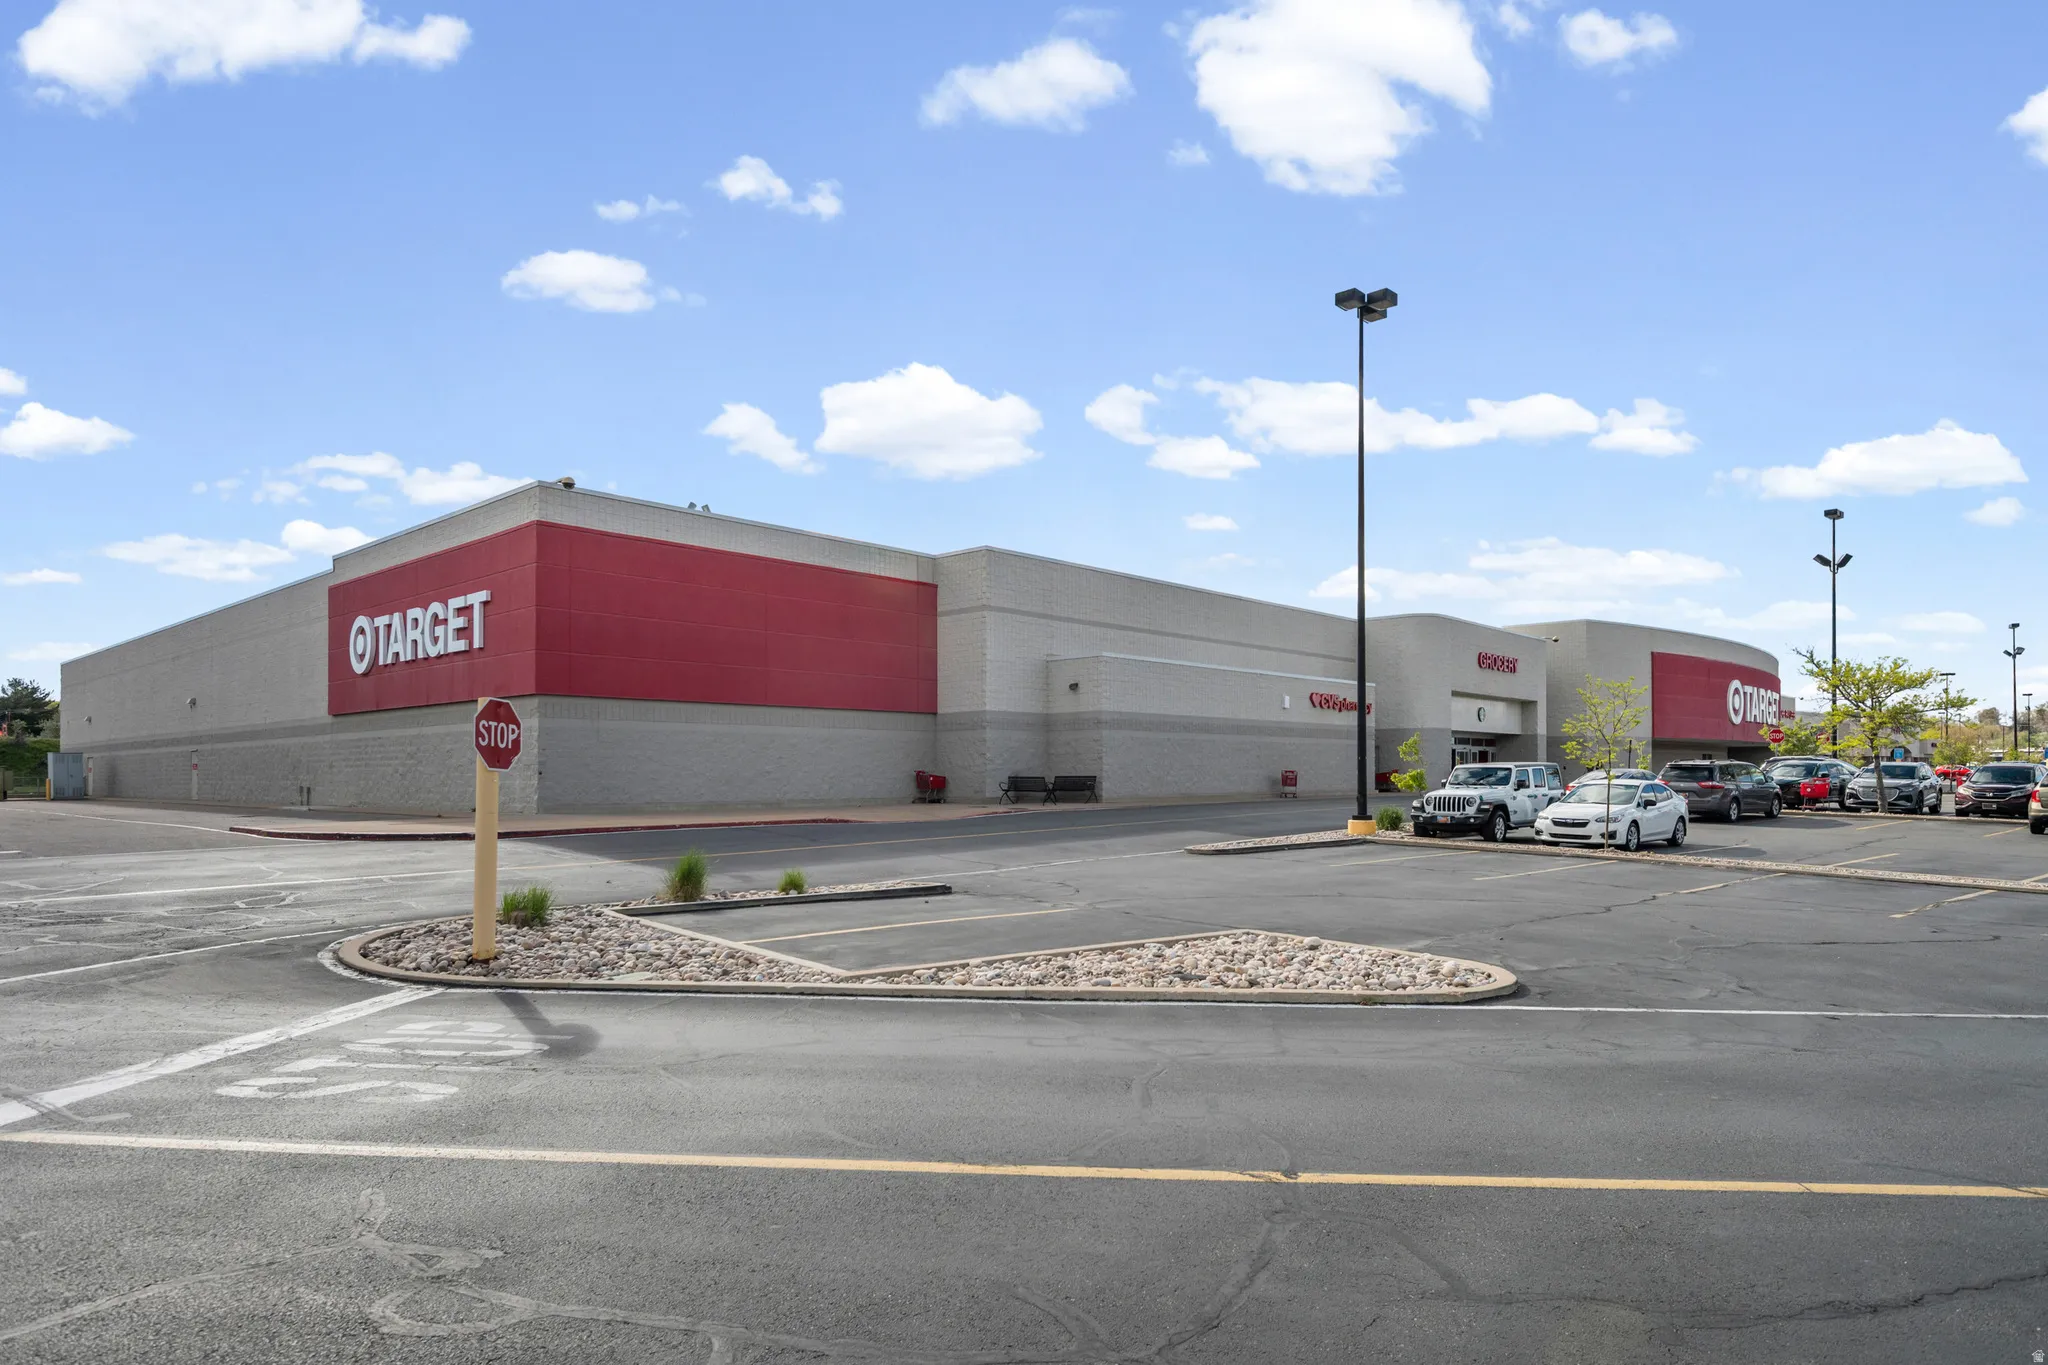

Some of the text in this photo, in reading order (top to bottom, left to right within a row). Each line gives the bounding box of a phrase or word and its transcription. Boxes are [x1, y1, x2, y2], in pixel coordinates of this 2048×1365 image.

[374, 589, 492, 666] TARGET
[1478, 652, 1518, 673] GROCERY
[1320, 693, 1373, 715] CVS phary
[1743, 685, 1780, 726] TARGET
[478, 719, 520, 749] STOP
